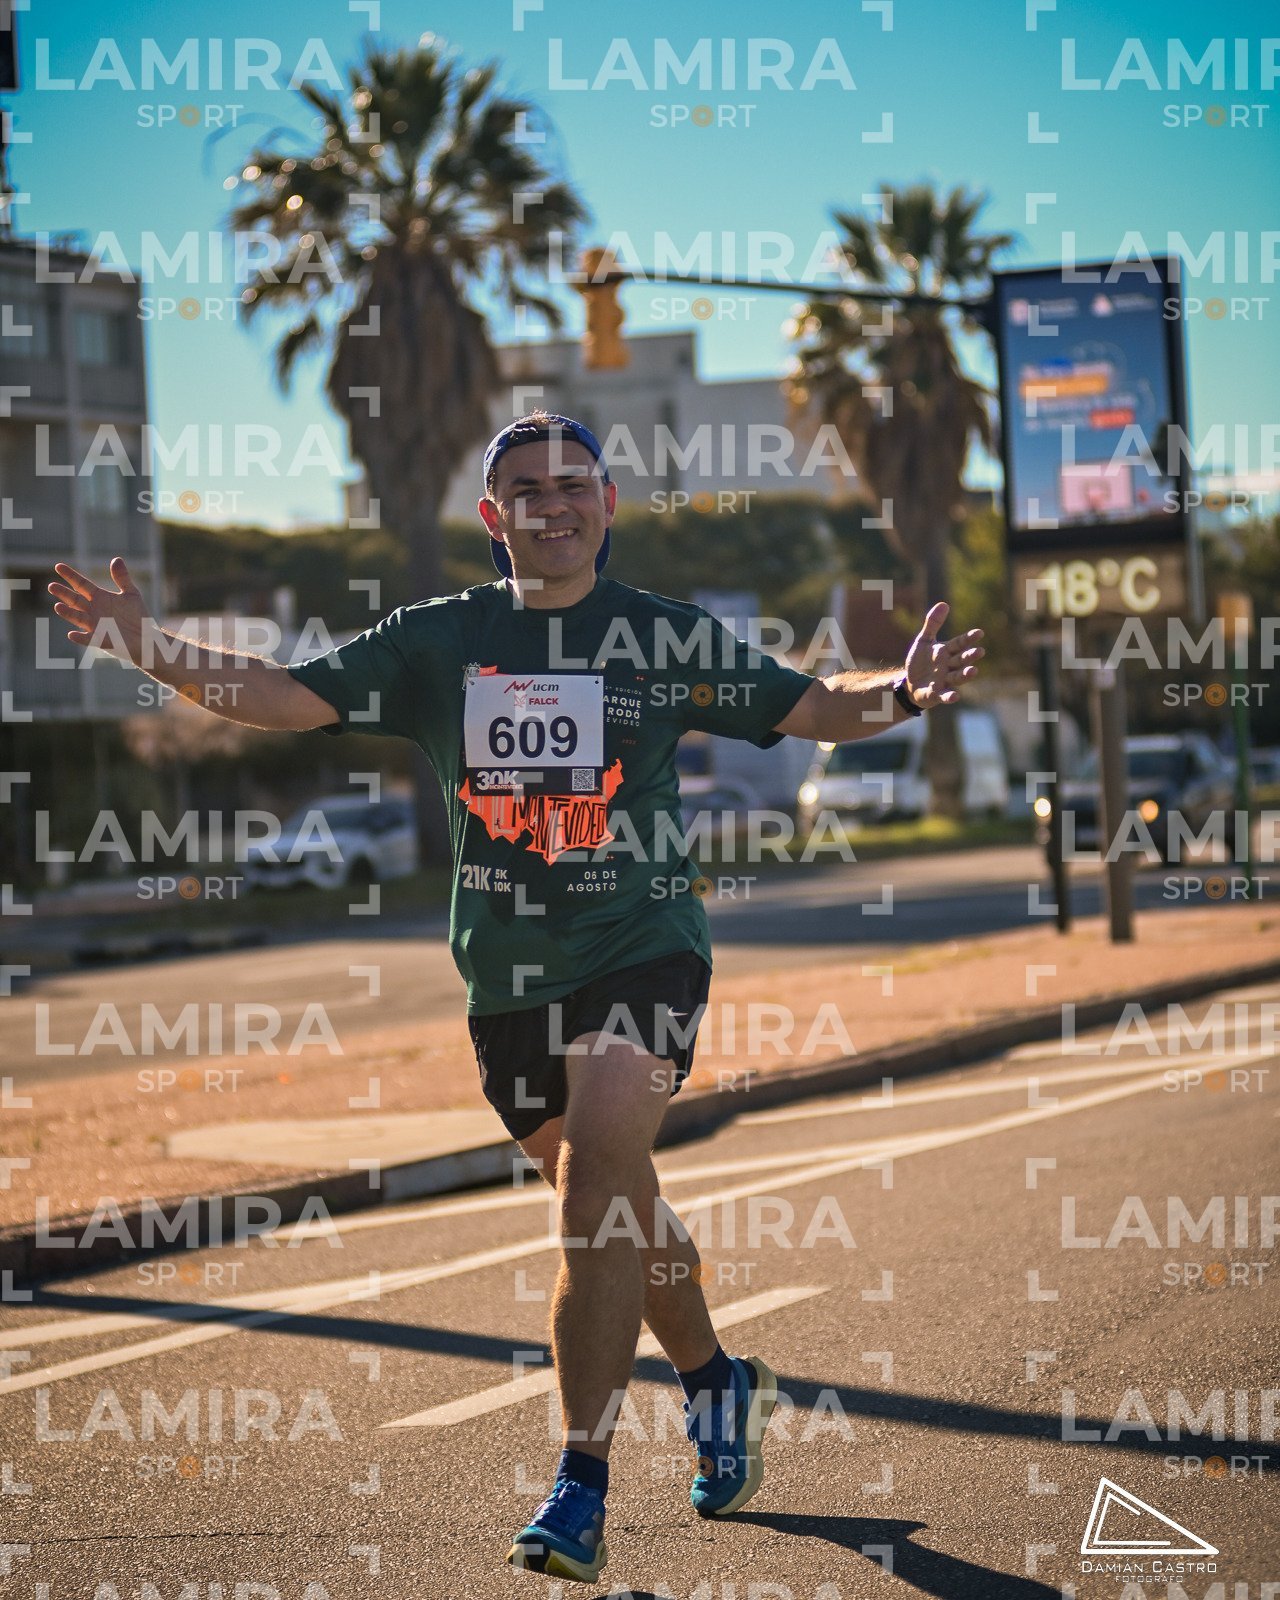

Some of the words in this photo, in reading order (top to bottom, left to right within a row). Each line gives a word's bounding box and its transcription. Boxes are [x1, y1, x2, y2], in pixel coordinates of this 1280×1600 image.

[1038, 556, 1161, 617] 18°C
[532, 683, 559, 692] ucm
[607, 707, 640, 719] RODÓ
[488, 715, 578, 758] 609
[476, 770, 520, 790] 30K
[461, 864, 491, 891] 21K
[494, 869, 508, 880] 5K
[584, 871, 597, 880] 06
[602, 870, 617, 879] DE
[493, 881, 511, 892] 10K
[566, 882, 617, 892] AGOSTO
